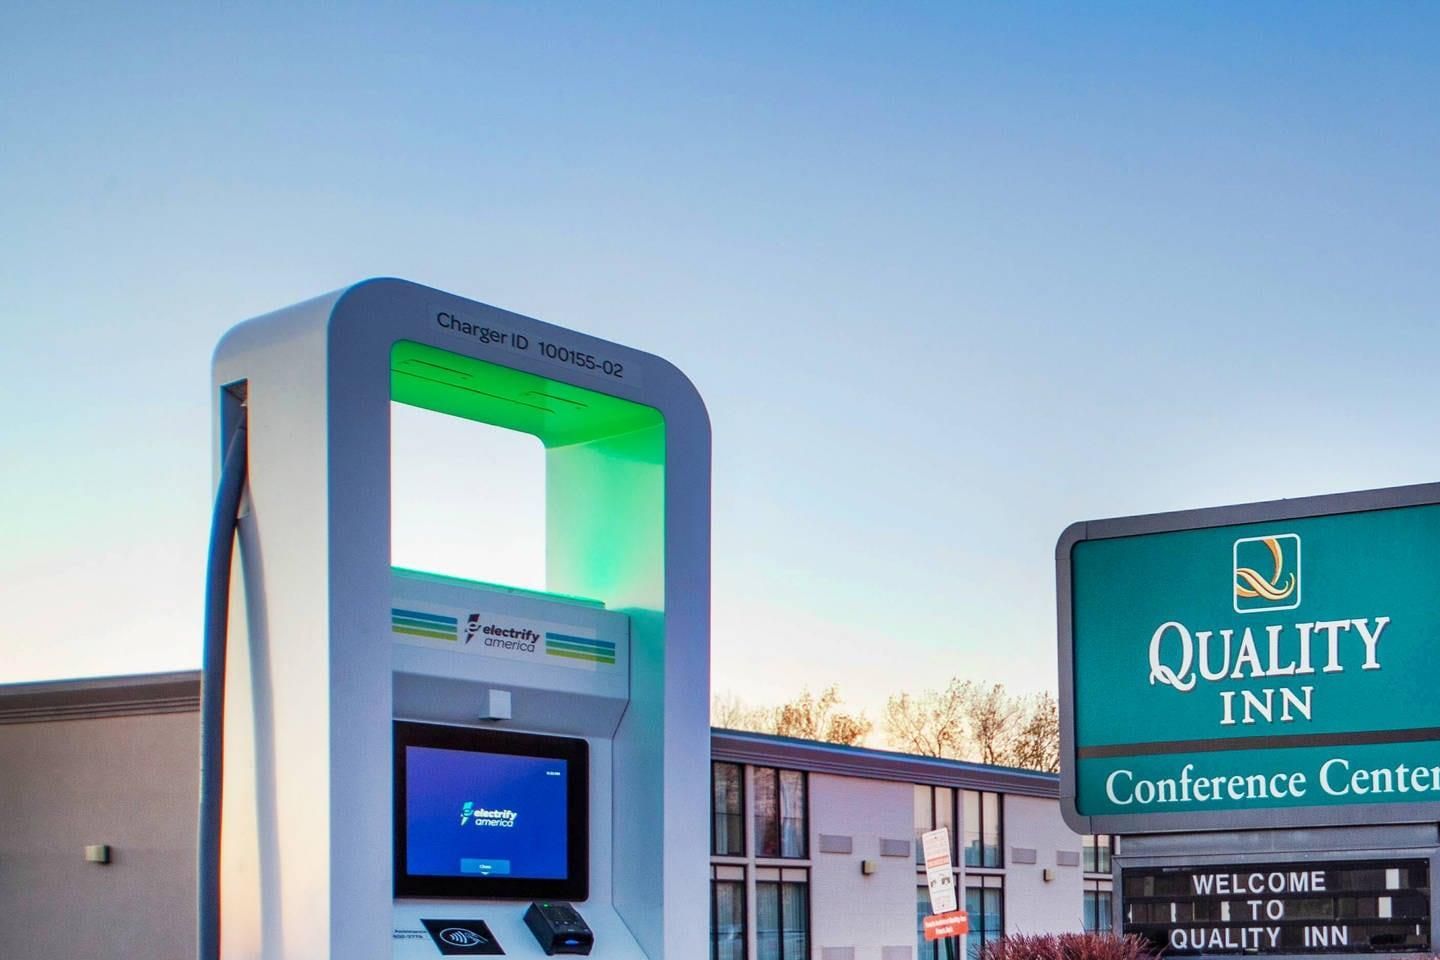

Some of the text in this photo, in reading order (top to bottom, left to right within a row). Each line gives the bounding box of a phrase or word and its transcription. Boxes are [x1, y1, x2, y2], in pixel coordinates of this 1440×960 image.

[437, 312, 624, 378] Charger ID 100155-02
[483, 624, 540, 643] electrify
[484, 637, 535, 653] america
[1148, 616, 1390, 692] QUALITY
[1219, 685, 1314, 725] INN
[1105, 763, 1306, 805] Conference
[474, 808, 517, 821] electrify
[475, 819, 514, 827] america
[1192, 871, 1326, 895] WELCOME
[1247, 900, 1284, 922] TO
[1170, 925, 1348, 950] QUALITY INN
